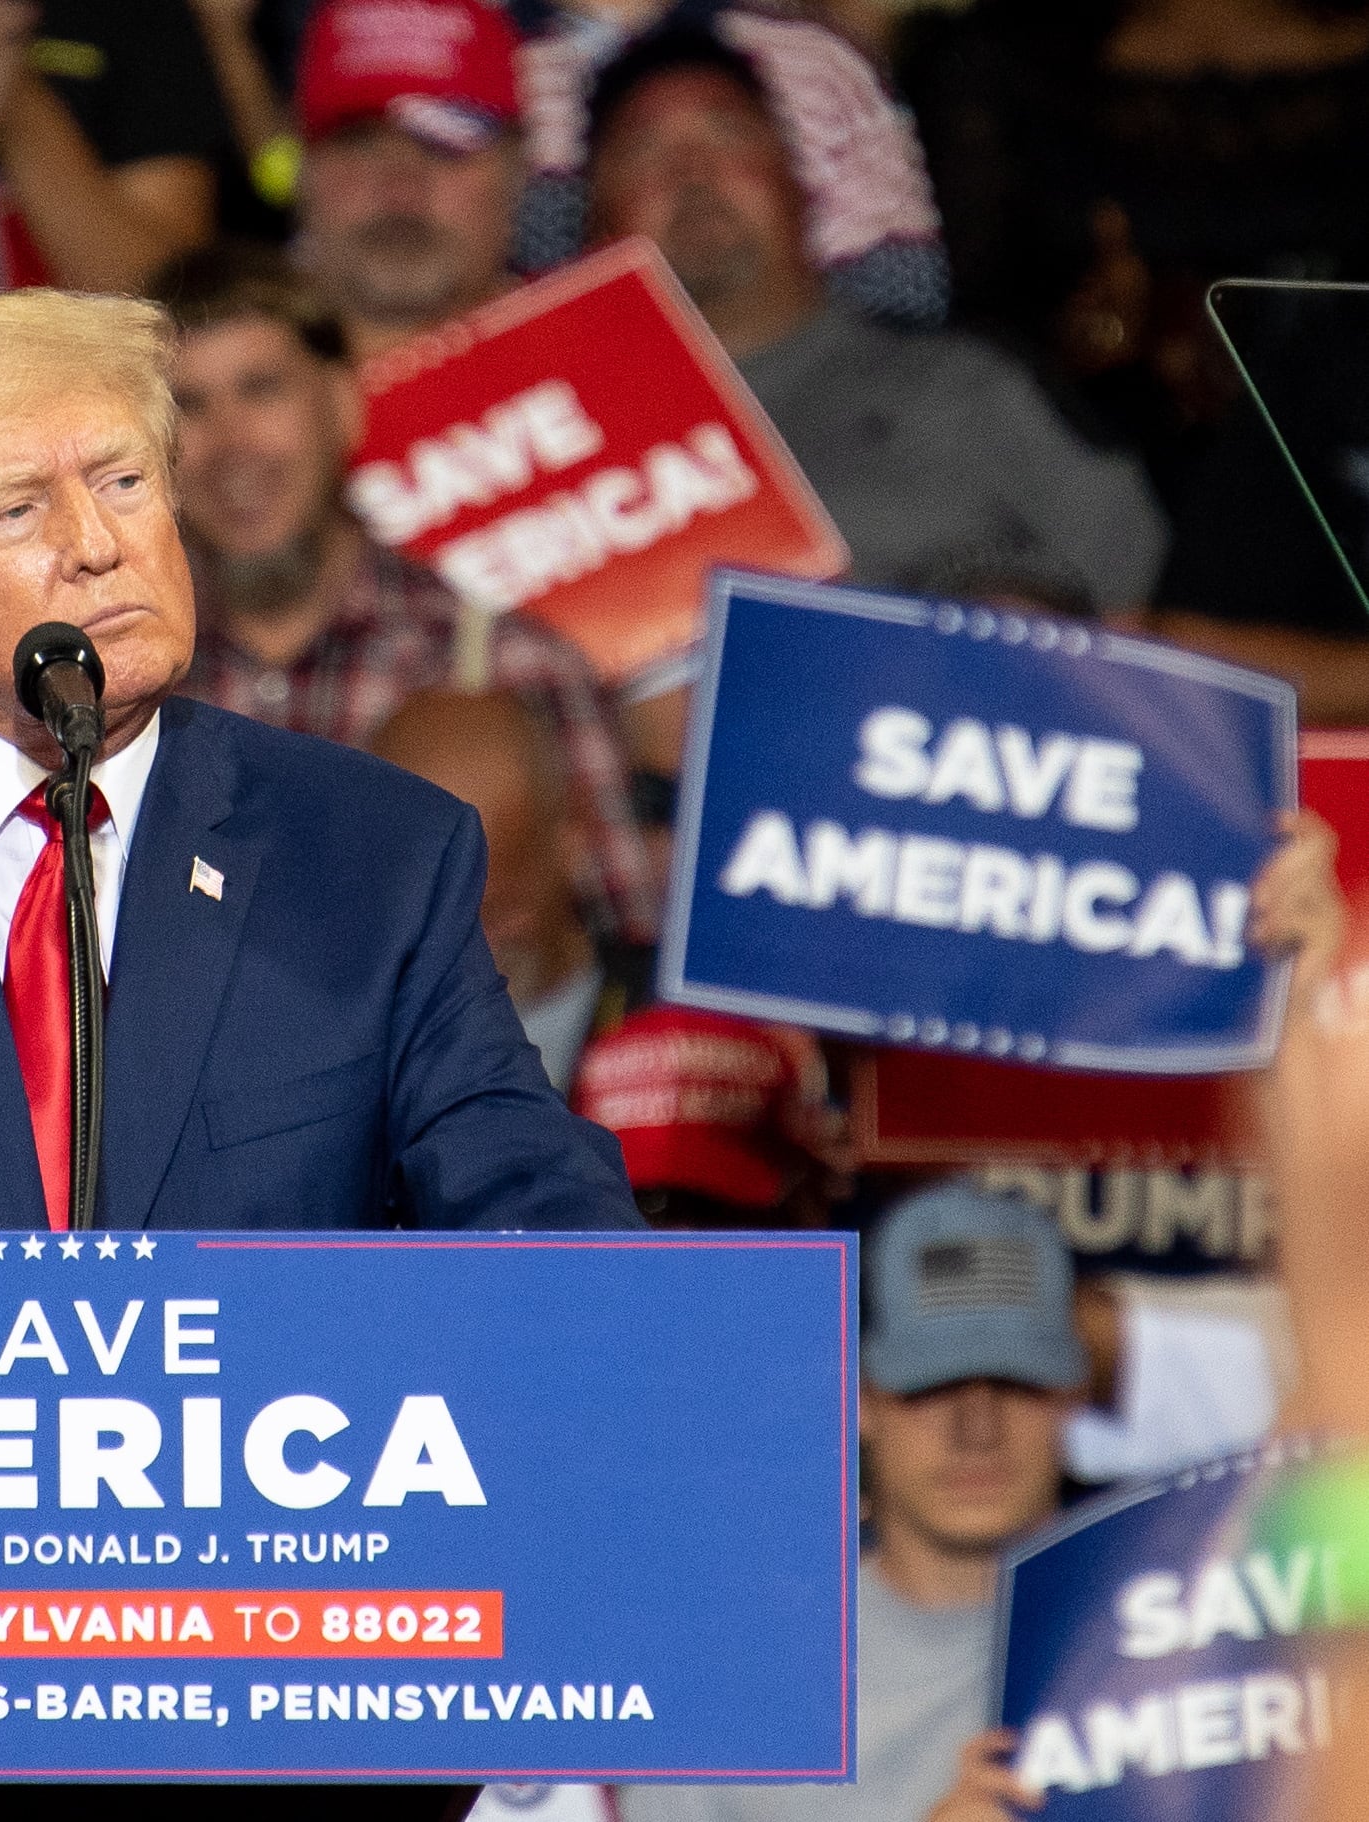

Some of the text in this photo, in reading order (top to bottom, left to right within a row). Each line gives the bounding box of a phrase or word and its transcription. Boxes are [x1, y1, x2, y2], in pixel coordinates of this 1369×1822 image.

[346, 376, 607, 549] SAVE
[435, 420, 761, 612] ERICA!
[856, 704, 1145, 834] SAVE
[719, 809, 1251, 970] AMERICA!
[3, 1533, 182, 1565] DONALD
[198, 1534, 229, 1564] J.
[246, 1532, 390, 1563] TRUMP
[233, 1604, 301, 1643] TO
[321, 1604, 482, 1643] 88022
[250, 1684, 655, 1721] PENNSYLVANIA
[1014, 1666, 1332, 1796] AMERI
